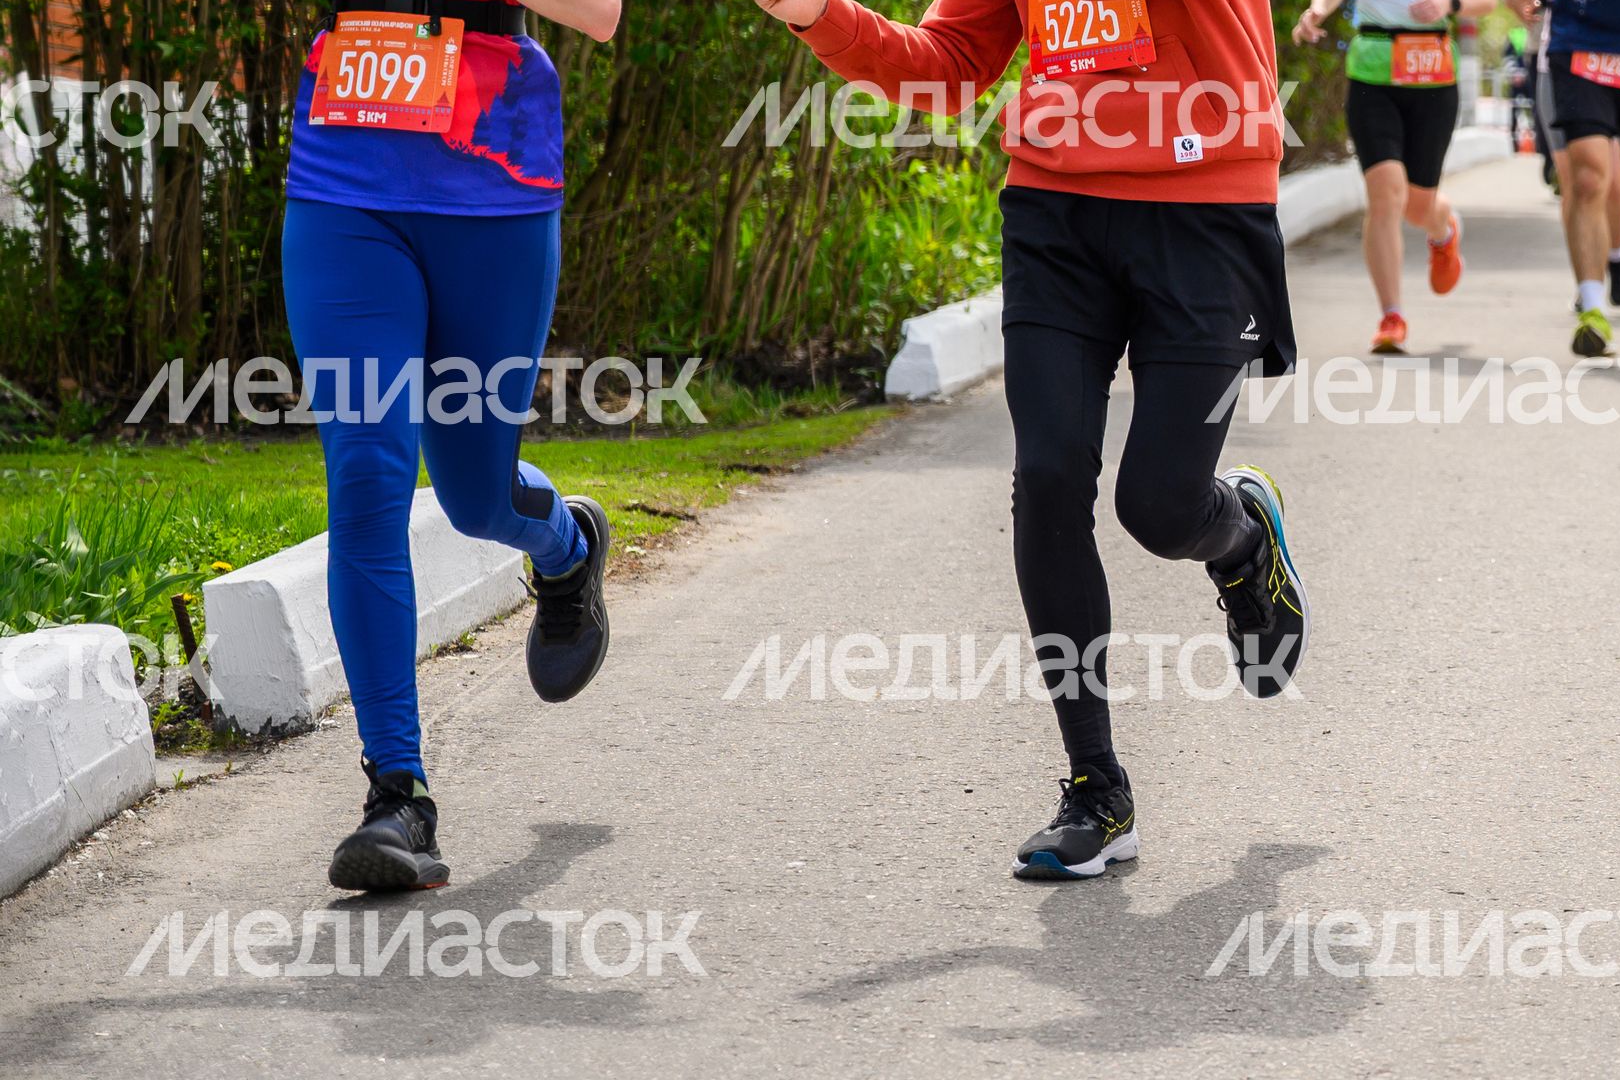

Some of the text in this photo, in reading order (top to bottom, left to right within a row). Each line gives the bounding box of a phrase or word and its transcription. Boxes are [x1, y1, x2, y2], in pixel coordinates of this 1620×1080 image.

[1044, 0, 1121, 52] 5225
[335, 50, 427, 102] 5099
[1406, 49, 1443, 74] 5197
